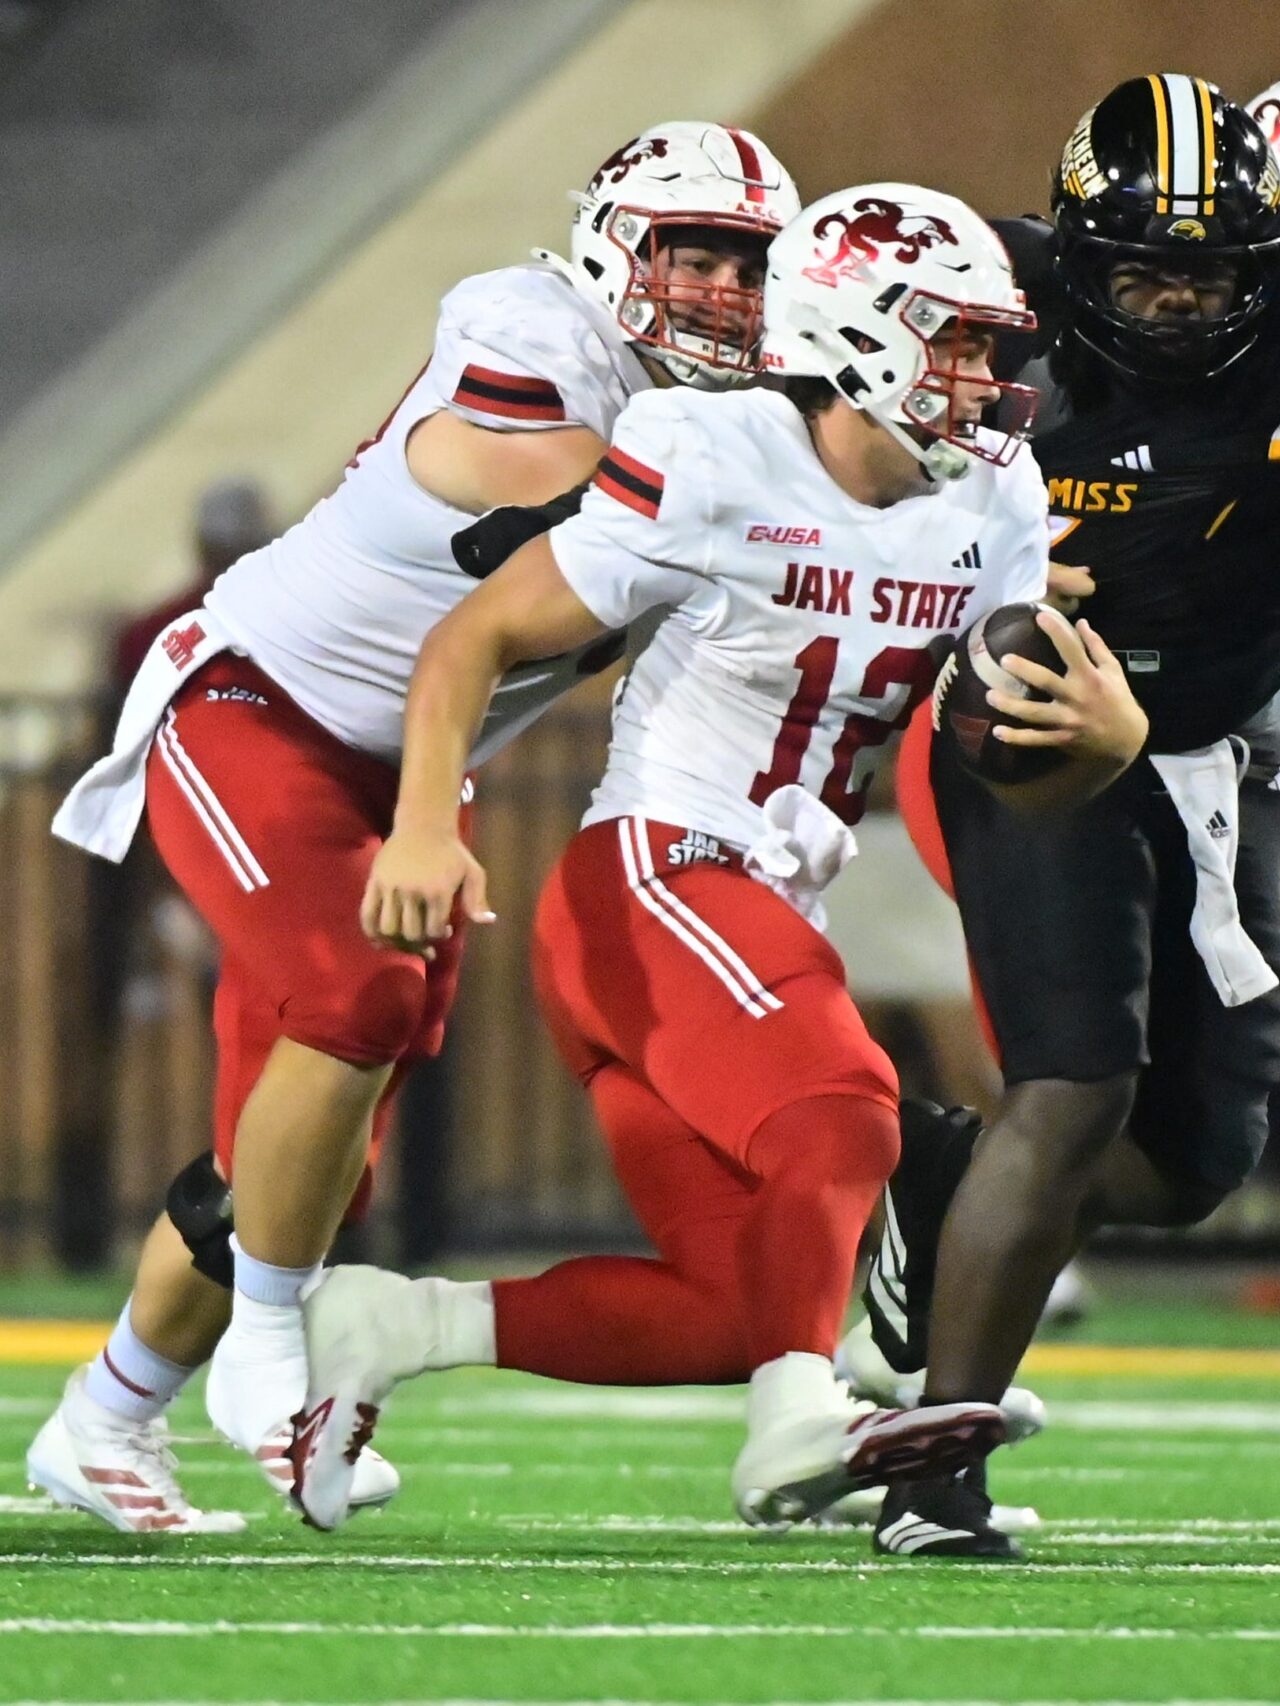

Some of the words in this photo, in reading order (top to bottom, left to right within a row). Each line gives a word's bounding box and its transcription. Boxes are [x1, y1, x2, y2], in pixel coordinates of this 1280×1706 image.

[1048, 478, 1138, 512] MISS
[771, 563, 854, 616] JAX
[870, 577, 976, 629] STATE
[748, 635, 937, 826] 12
